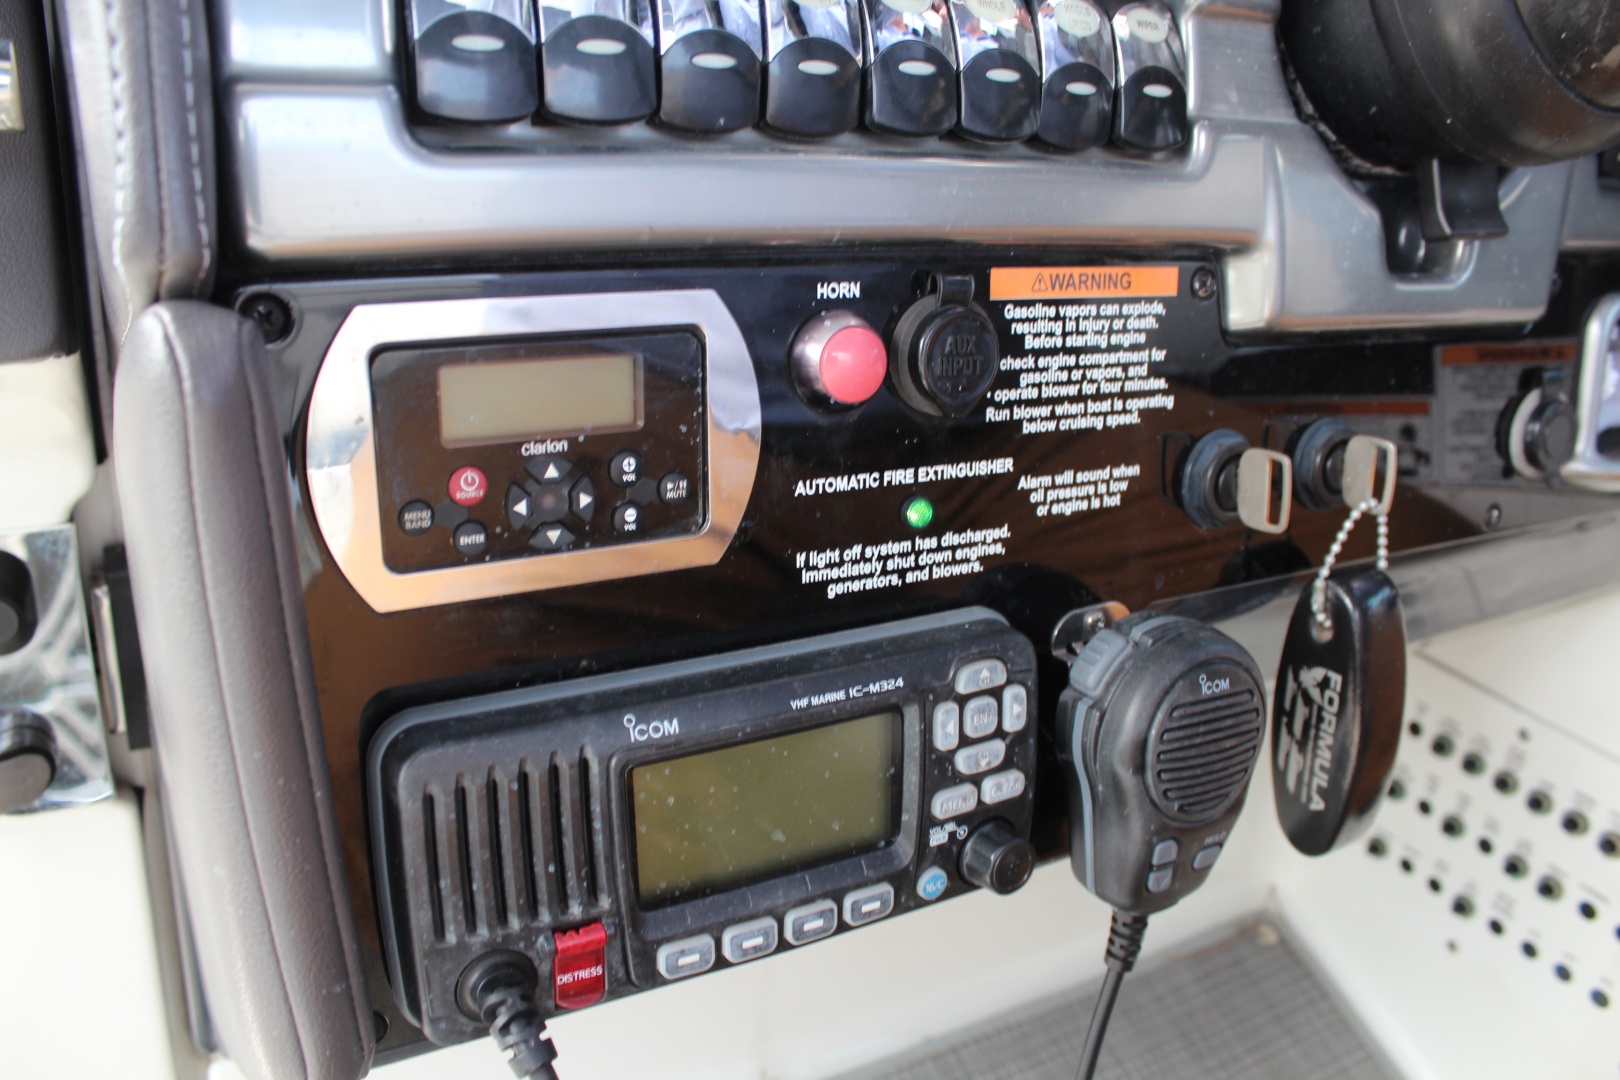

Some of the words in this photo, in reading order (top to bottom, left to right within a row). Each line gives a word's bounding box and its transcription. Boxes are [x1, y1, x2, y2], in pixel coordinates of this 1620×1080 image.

[816, 280, 861, 300] HORN
[1049, 271, 1132, 291] WARNING
[1004, 302, 1056, 320] Gasoline
[1059, 304, 1097, 321] vapors
[1099, 304, 1119, 316] can
[1121, 300, 1166, 318] explode,
[1011, 318, 1062, 336] resulting
[1065, 318, 1076, 333] in
[1078, 316, 1110, 333] injury
[1112, 318, 1125, 331] or
[1126, 315, 1159, 330] death.
[945, 335, 976, 355] AUX
[1024, 334, 1062, 349] Before
[1065, 332, 1108, 349] starting
[1110, 330, 1146, 347] engine
[937, 354, 984, 377] INPUT
[999, 354, 1035, 371] check
[1037, 352, 1076, 371] engine
[1078, 350, 1149, 368] compartment
[1151, 347, 1167, 362] for
[1019, 369, 1068, 388] gasoline
[1071, 368, 1084, 382] or
[1085, 366, 1125, 382] vapors,
[1127, 362, 1148, 378] and
[994, 386, 1039, 405] operate
[1041, 382, 1080, 399] blower
[1081, 380, 1098, 395] for
[1100, 378, 1122, 394] four
[1124, 376, 1169, 392] minutes.
[986, 406, 1010, 423] Run
[1013, 404, 1053, 421] blower
[1055, 401, 1085, 416] when
[1087, 398, 1112, 414] boat
[1113, 396, 1123, 412] is
[1125, 393, 1175, 414] operating
[1022, 418, 1057, 435] below
[1059, 413, 1104, 431] cruising
[1106, 412, 1141, 430] speed.
[521, 439, 568, 457] clarion
[622, 473, 636, 482] VOL
[794, 471, 880, 497] AUTOMATIC
[883, 467, 916, 487] FIRE
[918, 456, 1014, 483] EXTINGUISHER
[1017, 474, 1052, 491] Alarm
[1054, 469, 1074, 486] will
[1076, 465, 1111, 483] sound
[1111, 463, 1140, 479] when
[456, 489, 484, 500] SOURCE
[666, 490, 687, 500] MUTE
[1029, 487, 1045, 503] oil
[1046, 483, 1095, 504] pressure
[1097, 480, 1107, 495] is
[1109, 479, 1129, 493] low
[404, 508, 431, 521] MENU
[1036, 503, 1049, 517] or
[1051, 497, 1089, 516] engine
[1090, 495, 1101, 510] is
[1102, 492, 1121, 508] hot
[405, 520, 431, 530] BAND
[624, 522, 636, 531] VOL
[460, 532, 486, 546] ENTER
[796, 551, 806, 569] If
[809, 547, 840, 569] light
[843, 543, 862, 562] off
[864, 539, 912, 560] system
[915, 535, 938, 552] has
[886, 554, 915, 571] shut
[917, 550, 952, 568] down
[954, 542, 1006, 562] engines,
[826, 574, 903, 599] generators,
[905, 566, 930, 584] and
[932, 561, 984, 580] blowers.
[790, 696, 809, 711] VHF
[810, 688, 847, 707] MARINE
[848, 676, 905, 699] IC-M324
[973, 709, 994, 727] ENT
[1308, 669, 1343, 812] FORMULA
[942, 794, 974, 814] MENU
[557, 964, 604, 986] DISTRESS
